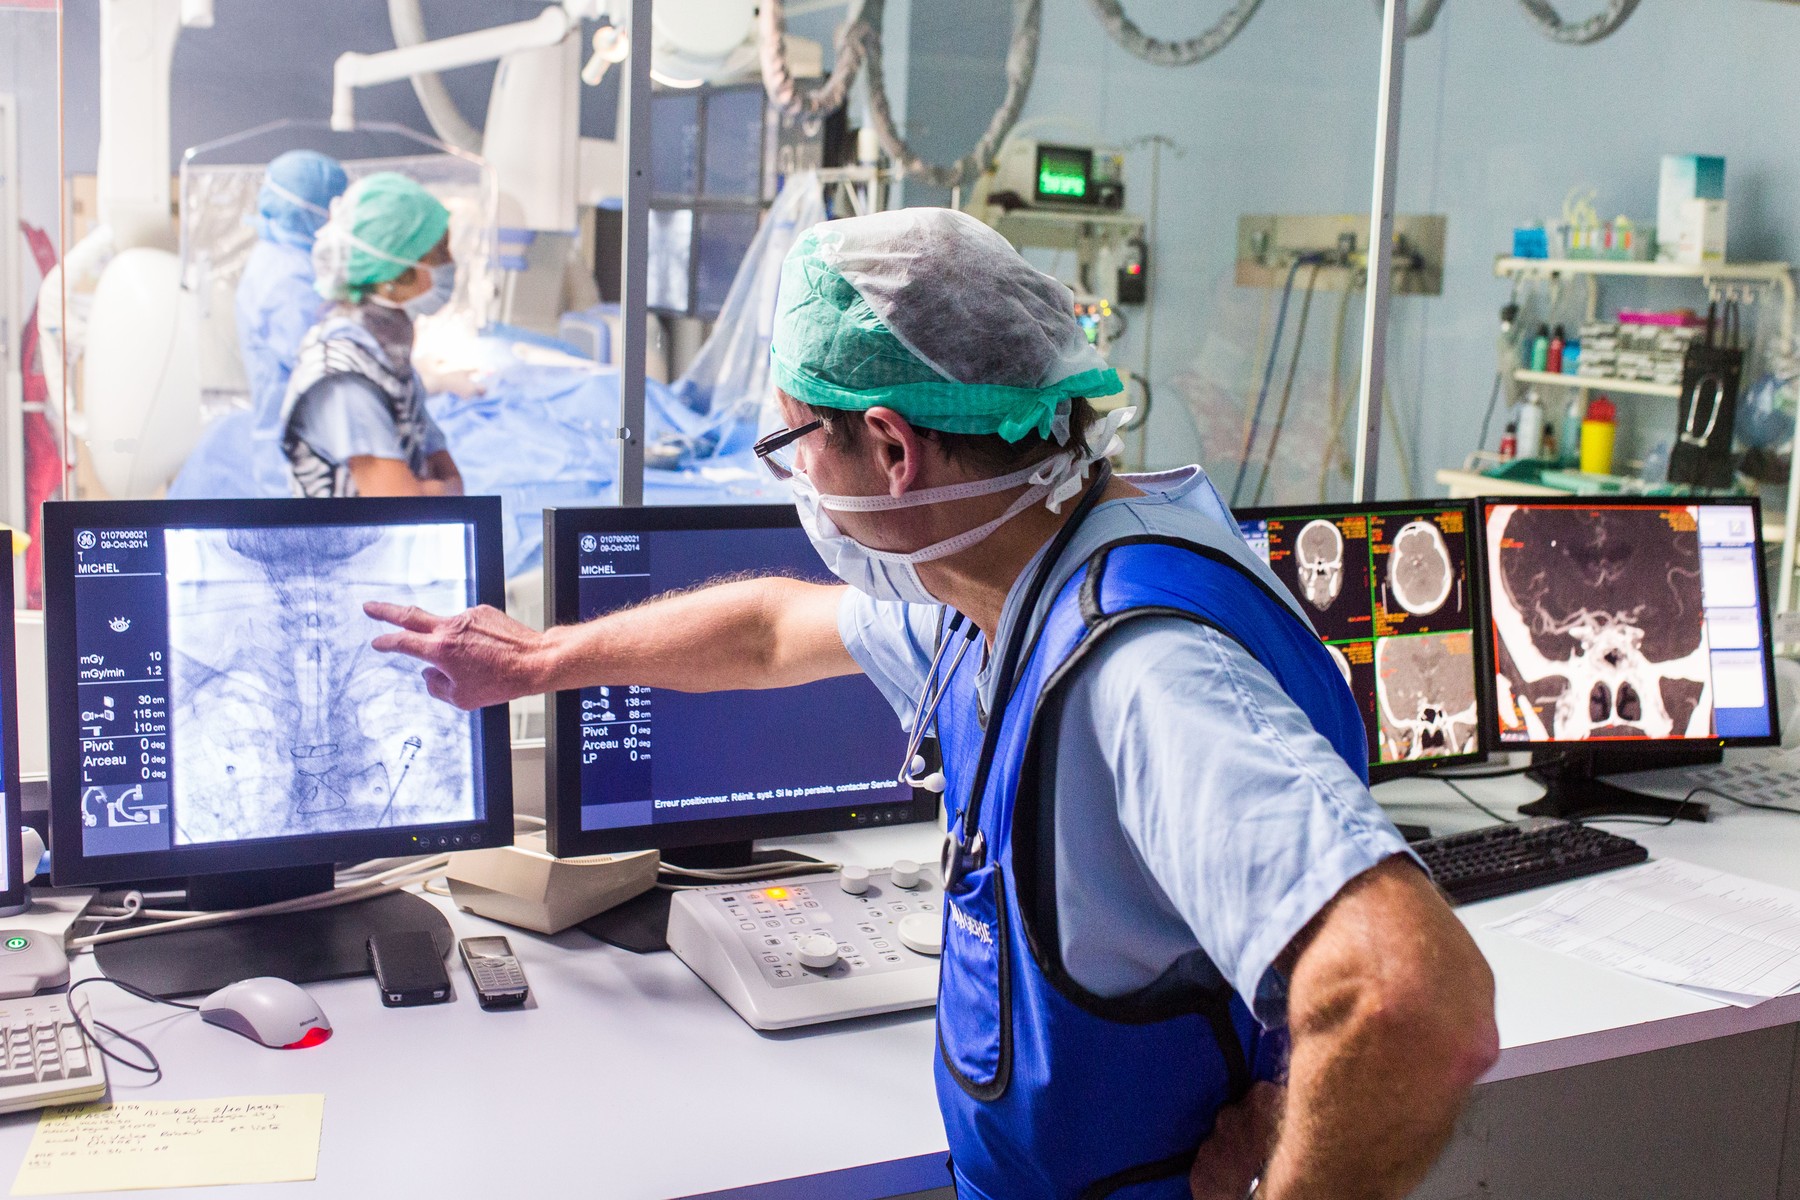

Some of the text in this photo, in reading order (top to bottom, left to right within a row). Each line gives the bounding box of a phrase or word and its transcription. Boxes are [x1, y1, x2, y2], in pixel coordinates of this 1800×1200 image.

[101, 540, 149, 549] 09-Oct-2014
[600, 543, 640, 552] 09-Oct-2014
[78, 563, 120, 574] MICHEL
[581, 564, 616, 575] MICHEL
[80, 651, 162, 666] mGy 10
[80, 665, 162, 680] mGy/min 1.2
[628, 685, 640, 694] 30
[138, 695, 165, 705] 30 cm
[624, 698, 640, 707] 138
[133, 709, 166, 719] 115 cm
[628, 710, 640, 719] 88
[140, 722, 166, 733] 10 cm
[582, 723, 651, 737] Pivot 0 deg
[82, 737, 166, 753] Pivot 0 deg
[582, 737, 651, 751] Arceau 90 deg
[83, 752, 166, 768] Arceau 0 deg
[583, 753, 598, 764] LP
[630, 750, 638, 762] 0
[83, 766, 167, 782] L 0 deg
[654, 799, 680, 809] Erreur
[680, 795, 730, 808] positionneur.
[756, 790, 775, 801] syst.
[793, 787, 804, 798] pb
[804, 785, 836, 797] persiste,
[836, 782, 870, 793] contacter
[870, 779, 898, 789] Service
